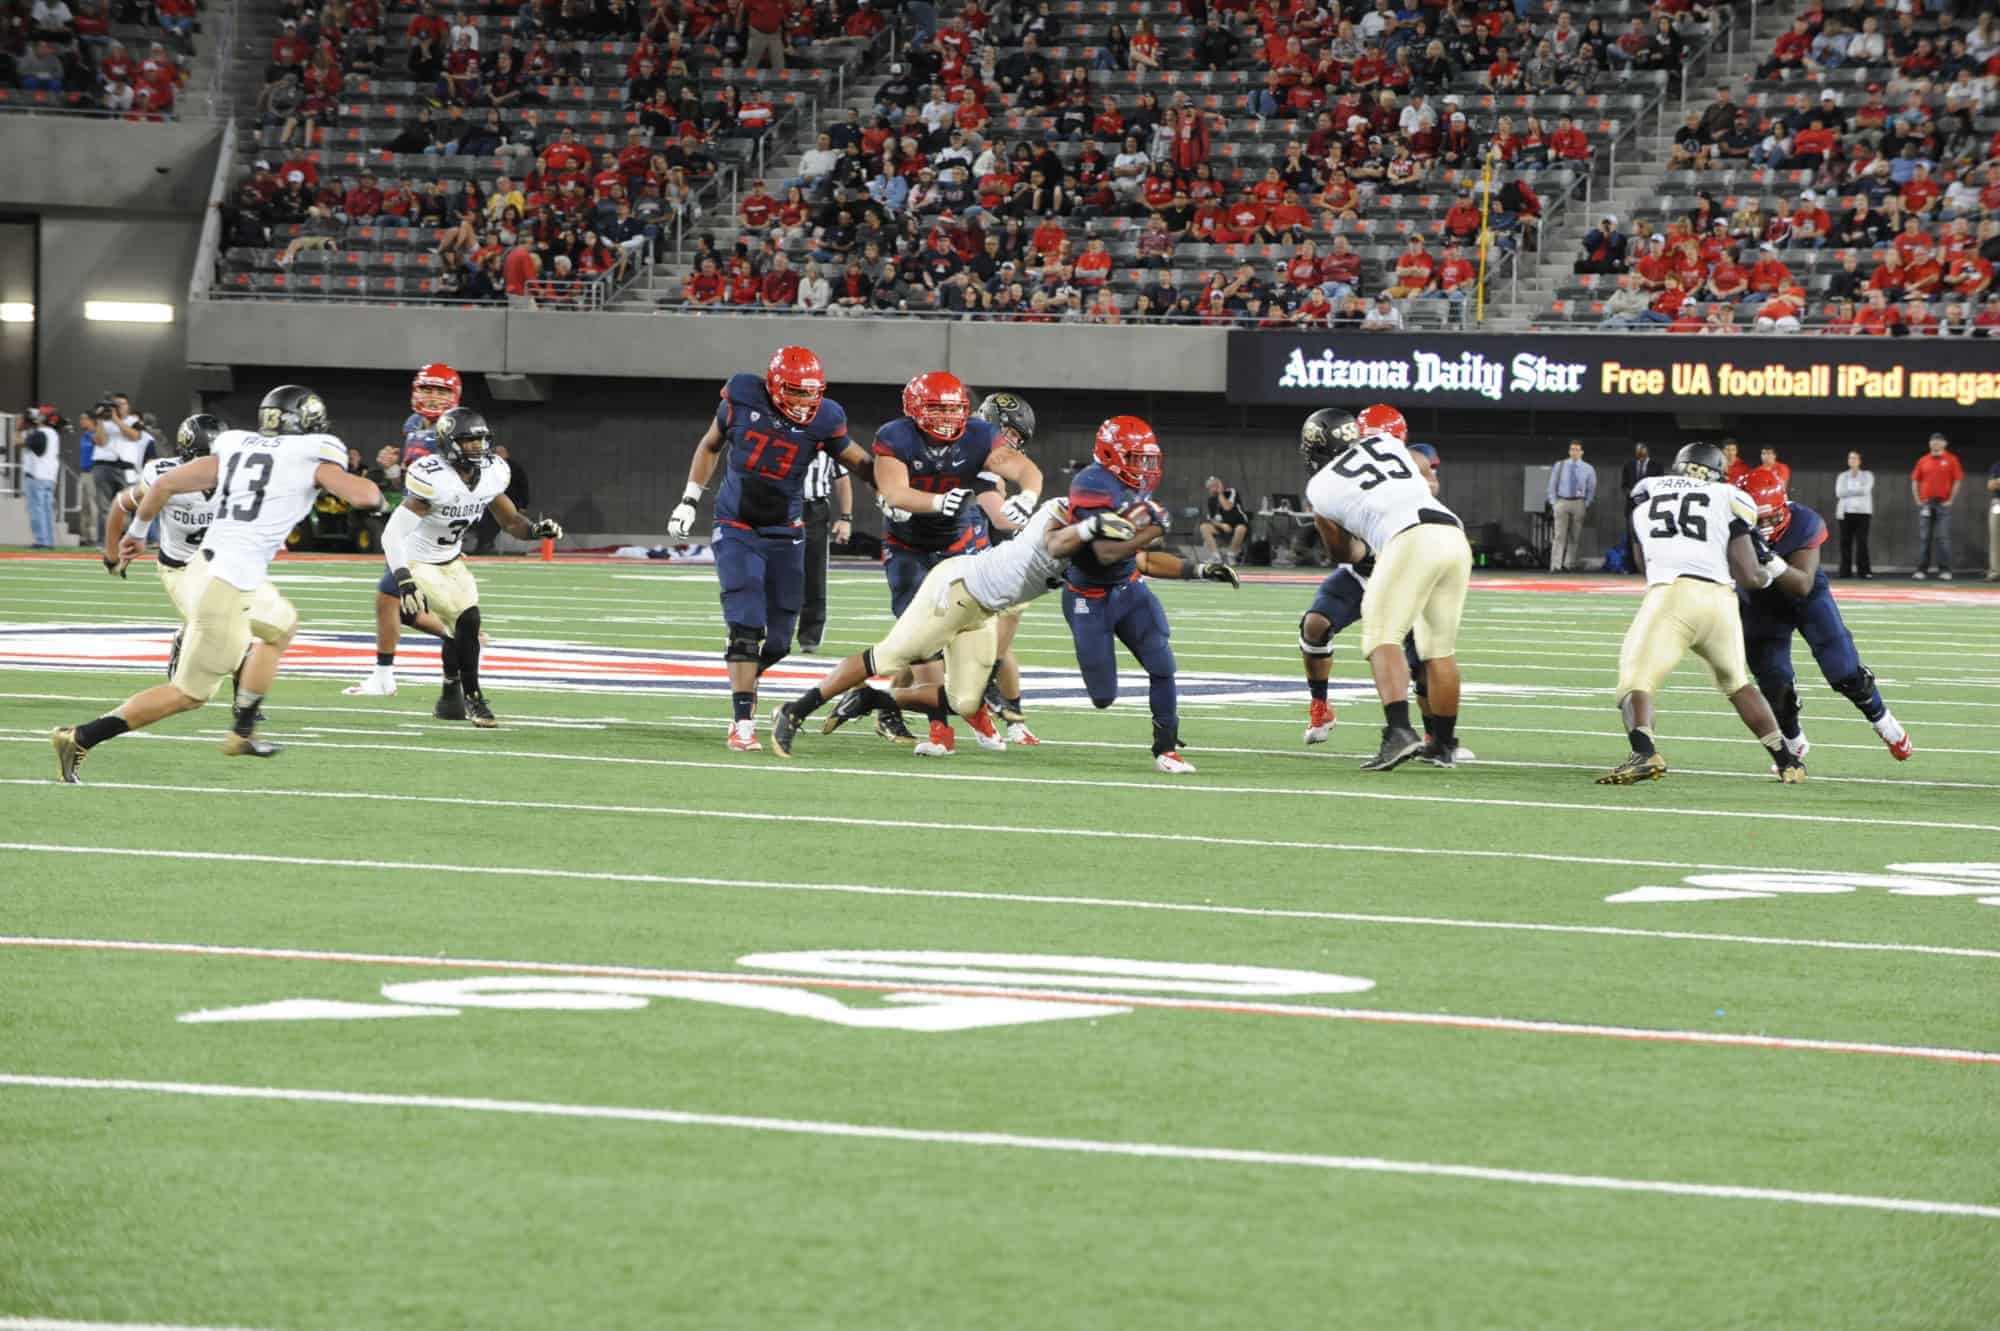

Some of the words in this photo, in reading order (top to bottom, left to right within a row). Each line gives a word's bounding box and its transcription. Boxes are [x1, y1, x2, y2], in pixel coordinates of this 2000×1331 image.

[1279, 349, 1410, 389] Arizona
[1413, 350, 1504, 399] Daily
[1510, 353, 1587, 393] Star
[1601, 362, 1664, 394] Free
[1671, 363, 1712, 395] UA
[1717, 364, 1829, 398] football
[1837, 364, 1904, 399] iPad
[418, 459, 444, 475] 31
[743, 430, 799, 480] 73
[1332, 436, 1412, 490] 55
[216, 452, 274, 522] 13
[1648, 492, 1711, 542] 56
